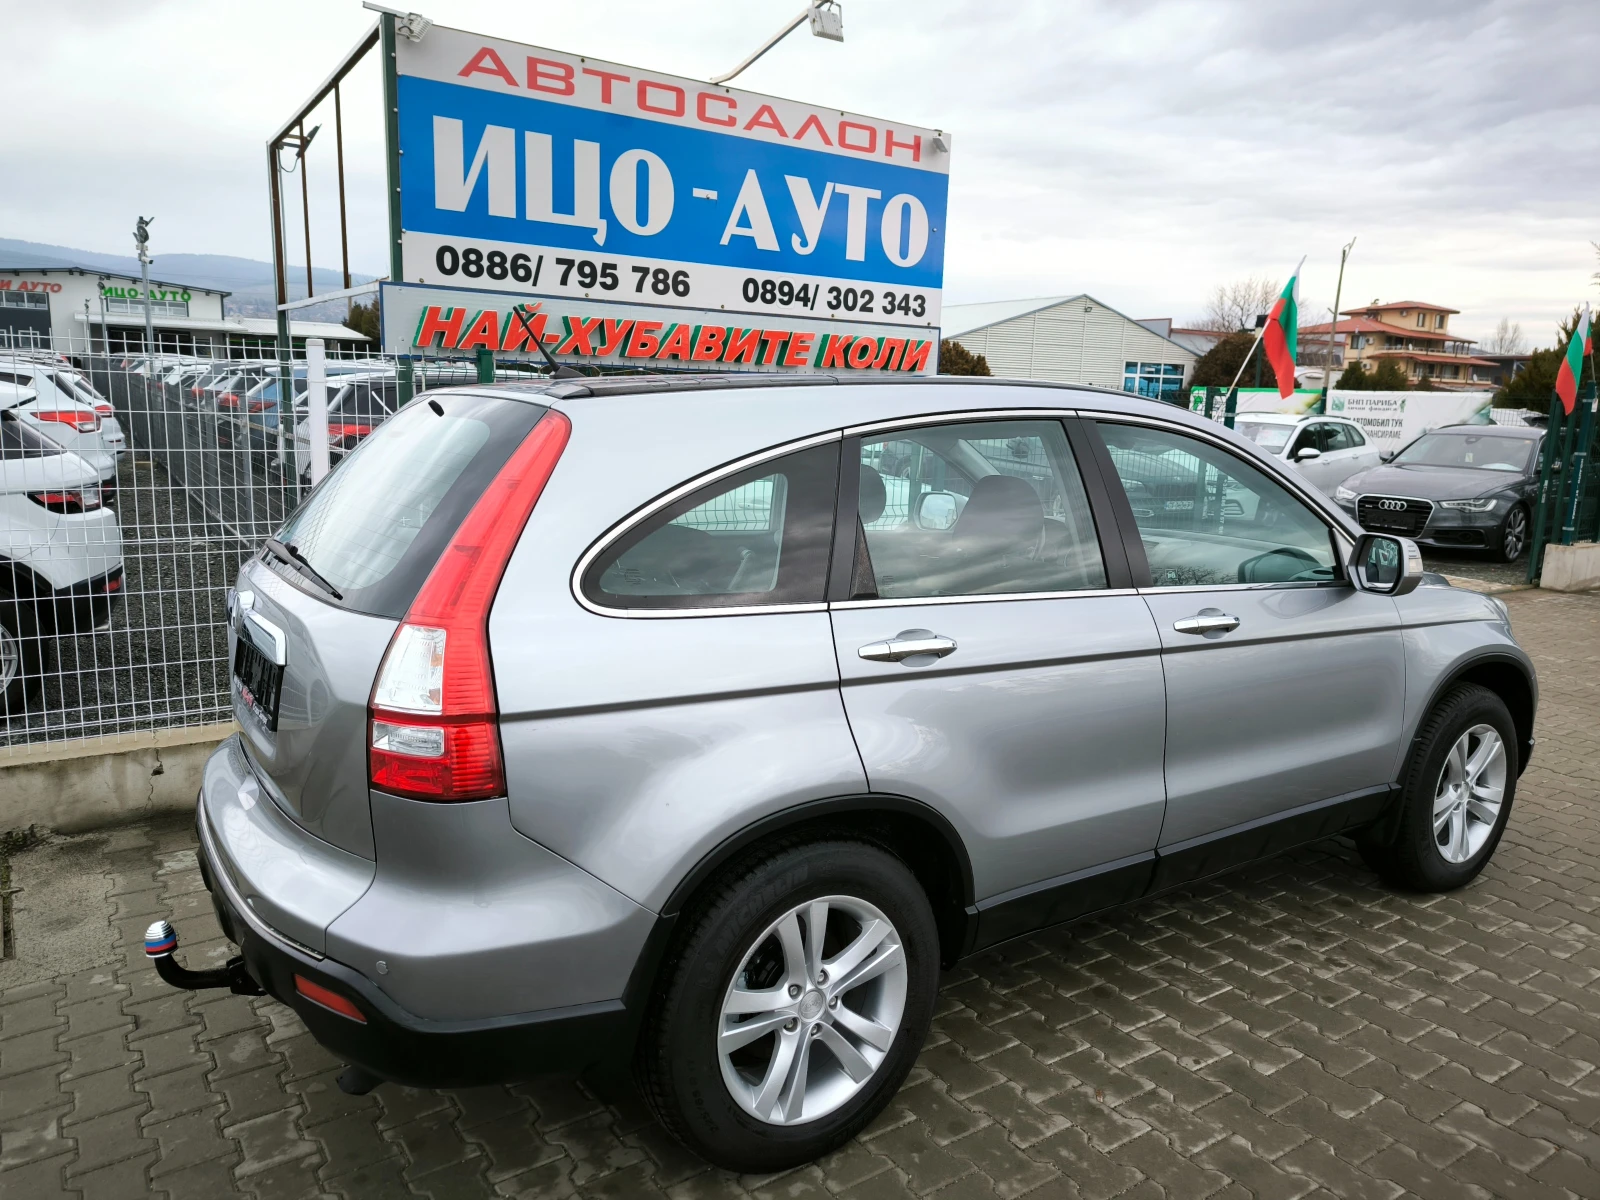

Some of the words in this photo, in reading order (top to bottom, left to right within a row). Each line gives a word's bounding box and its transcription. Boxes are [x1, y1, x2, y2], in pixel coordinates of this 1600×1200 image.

[458, 46, 922, 163] АВТОСАЛОН
[18, 280, 63, 293] АУТО
[435, 245, 544, 287] 0886/
[555, 257, 619, 291] 795
[631, 265, 691, 298] 786
[742, 277, 820, 311] 0894/
[826, 286, 875, 313] 302
[882, 291, 926, 318] 343
[412, 303, 816, 369] НАЙ-ХУБАВИТЕ
[815, 333, 933, 373] КОЛИ
[1391, 419, 1403, 427] ТУК
